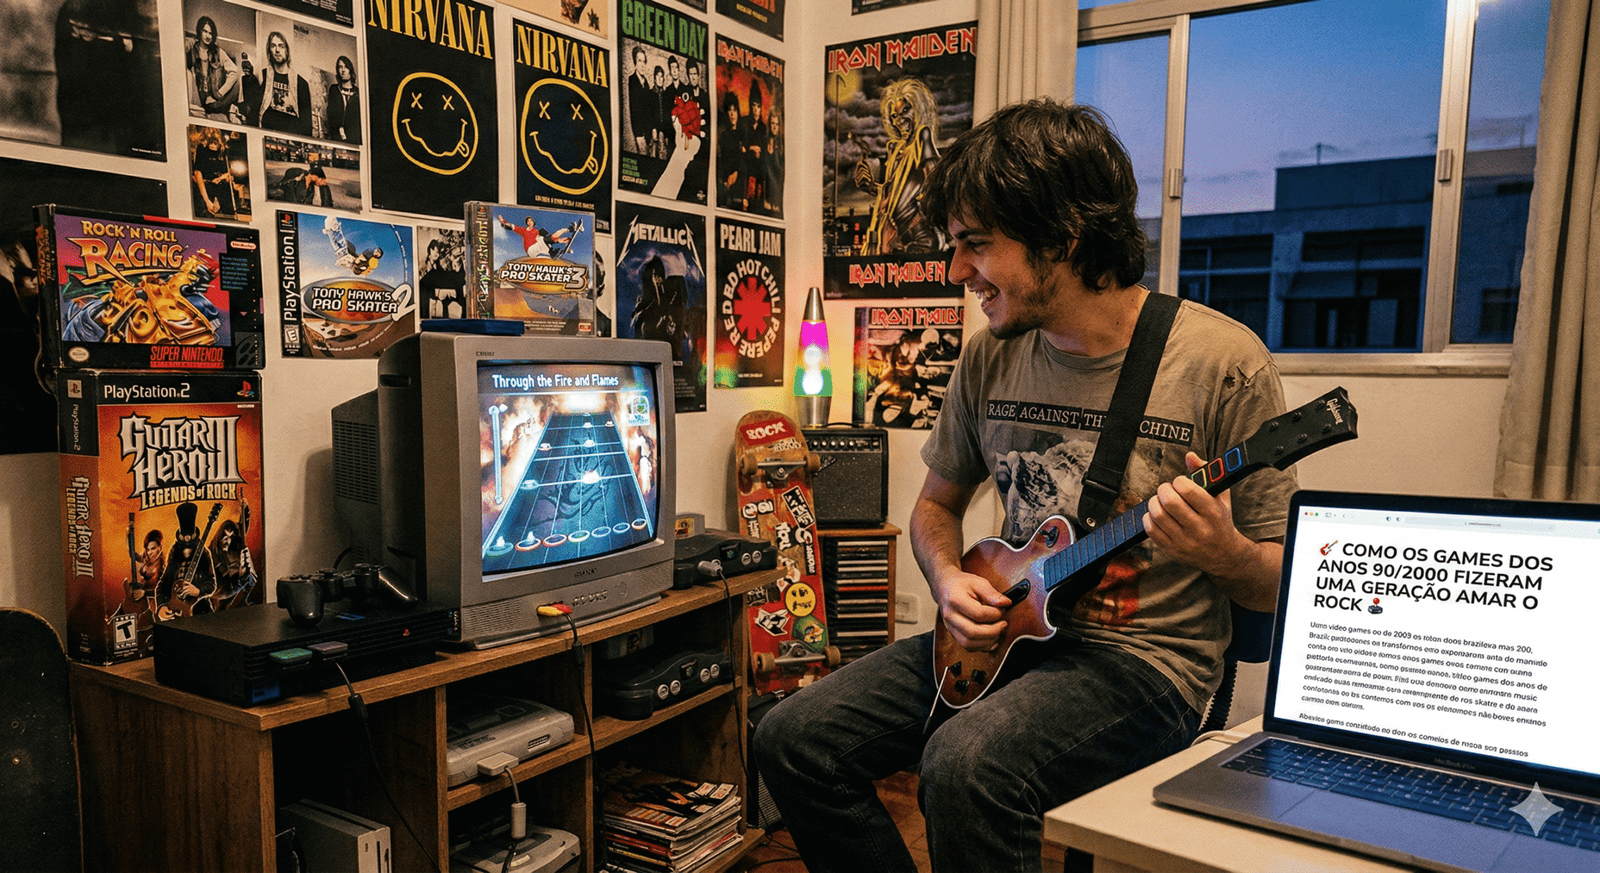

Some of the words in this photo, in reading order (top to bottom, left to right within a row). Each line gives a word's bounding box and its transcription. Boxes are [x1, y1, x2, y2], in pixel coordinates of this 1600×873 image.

[368, 0, 493, 59] NIRVANA
[622, 0, 676, 50] GREEN
[679, 17, 706, 61] DAY
[515, 24, 608, 88] NIRVANA
[828, 42, 881, 75] IRON
[885, 27, 977, 69] MAIDEN
[81, 220, 125, 238] ROCK
[143, 227, 177, 242] ROLL
[719, 223, 756, 254] PEARL
[759, 230, 781, 257] JAM
[616, 214, 706, 278] METALLICA
[67, 237, 183, 287] RACING
[508, 263, 533, 272] TONY
[849, 262, 885, 288] IRON
[886, 260, 946, 288] MAIDEN
[283, 235, 300, 321] PlayStation
[501, 271, 525, 280] PRO
[529, 273, 571, 283] SKATER
[565, 267, 587, 290] 3
[737, 259, 761, 279] HOT
[761, 266, 781, 313] CHILI
[312, 299, 342, 311] PRO
[348, 301, 398, 313] SKATER
[391, 284, 417, 321] 2
[313, 287, 345, 298] TONY
[348, 290, 391, 301] HAWK'S
[871, 308, 913, 332] IRON
[915, 307, 964, 328] MAID
[150, 346, 180, 361] SUPER
[492, 374, 535, 391] Through
[537, 374, 552, 387] the
[554, 374, 573, 387] Fire
[574, 374, 590, 386] and
[592, 373, 619, 386] Flames
[988, 403, 1016, 418] RAGE
[1019, 406, 1080, 425] AGAINST
[1084, 413, 1107, 428] TH
[141, 485, 195, 510] LEGENDS
[206, 483, 236, 500] ROCK
[1342, 543, 1397, 559] COMO
[1403, 547, 1428, 561] OS
[1434, 549, 1503, 567] GAMES
[1509, 555, 1553, 571] DOS
[1317, 559, 1367, 575] ANOS
[1372, 563, 1448, 582] 90/2000
[1454, 570, 1542, 590] FIZERAM
[1314, 594, 1363, 611] ROCK
[1316, 576, 1356, 592] UMA
[1361, 580, 1451, 602] GERAÇÃO
[1456, 589, 1516, 608] AMAR
[1523, 595, 1538, 610] O
[117, 620, 132, 639] T
[1512, 693, 1538, 702] music
